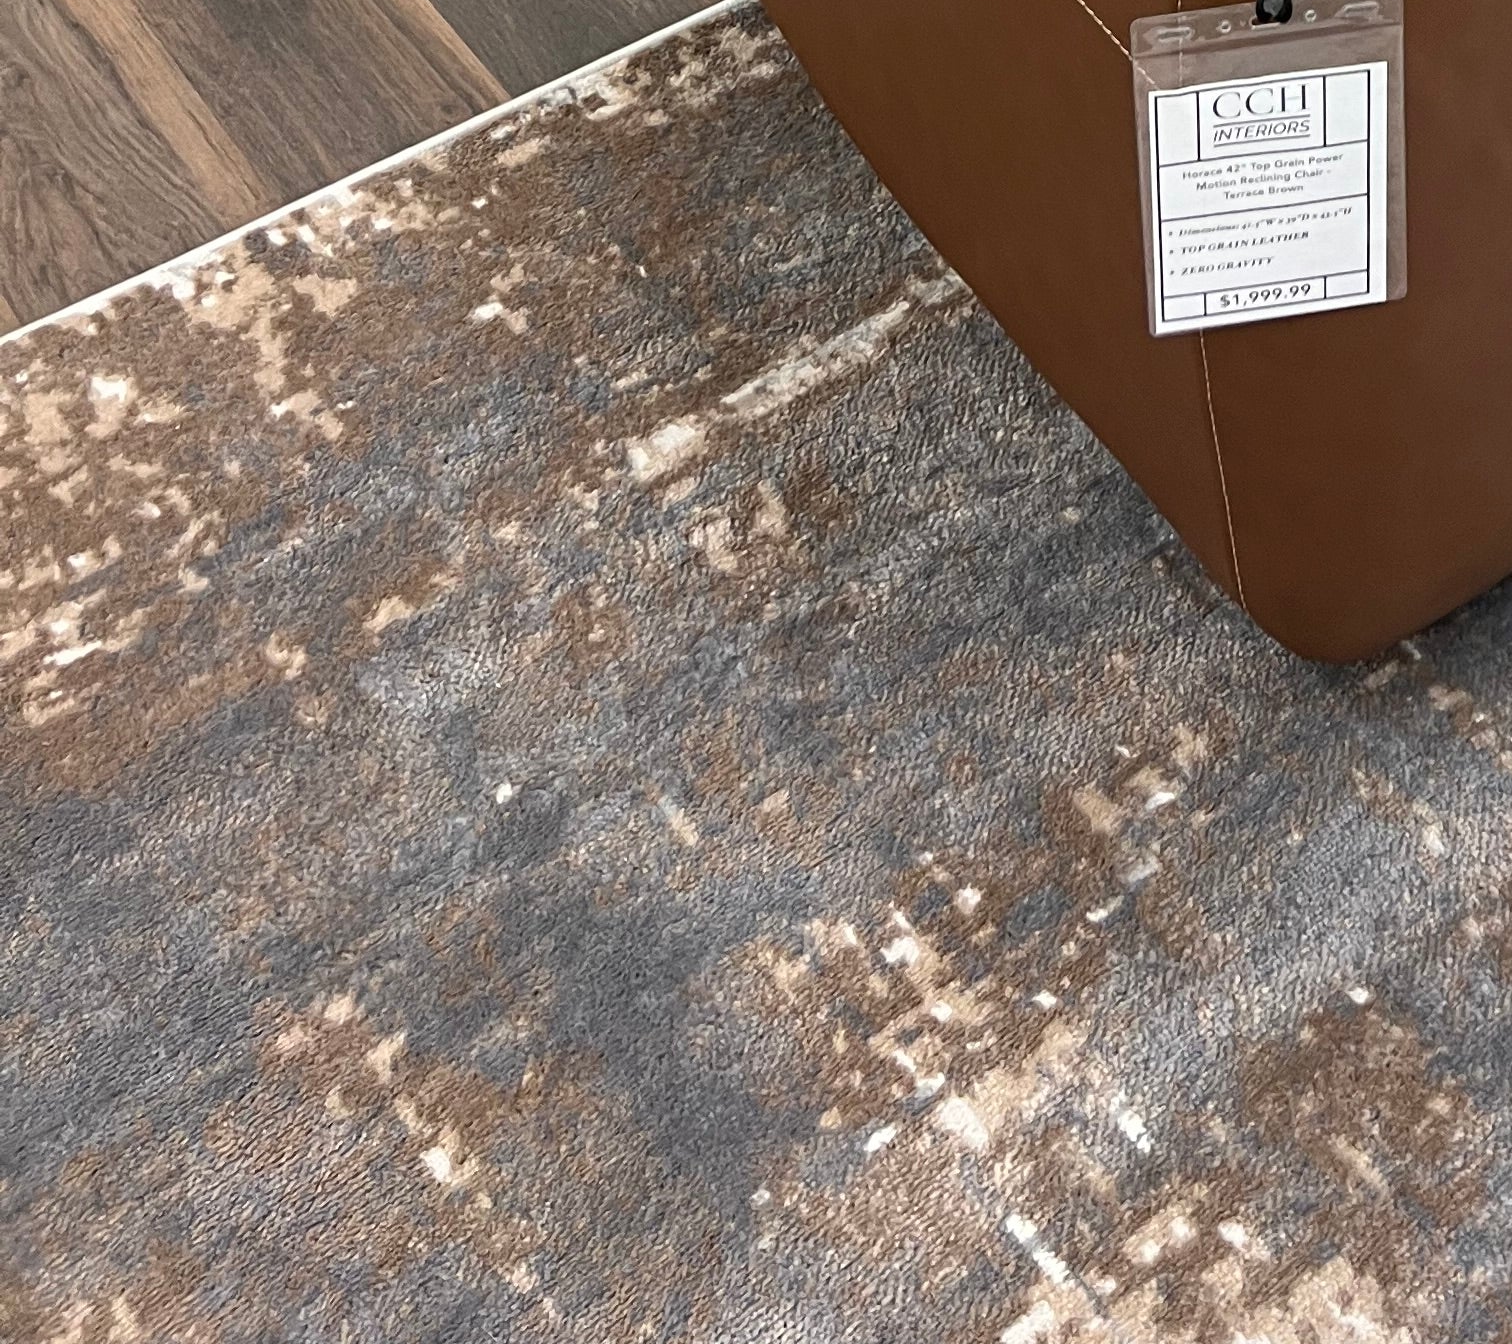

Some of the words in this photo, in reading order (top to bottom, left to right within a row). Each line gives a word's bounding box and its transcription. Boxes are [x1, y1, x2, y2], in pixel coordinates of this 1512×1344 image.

[1212, 84, 1309, 119] CCH
[1213, 120, 1311, 143] INTERIORS
[1251, 162, 1271, 172] Top
[1274, 158, 1305, 169] Grain
[1308, 153, 1344, 165] Power
[1195, 180, 1237, 192] Motion
[1240, 173, 1291, 183] Reclining
[1294, 167, 1324, 179] Chair
[1223, 189, 1265, 200] Terrace
[1268, 184, 1304, 195] Brown
[1181, 243, 1206, 255] TOP
[1207, 238, 1249, 251] GRAIN
[1251, 231, 1310, 247] LEATHER
[1181, 264, 1215, 276] ZERO
[1217, 255, 1275, 270] GRAVITY
[1219, 283, 1312, 309] $1,999.99
